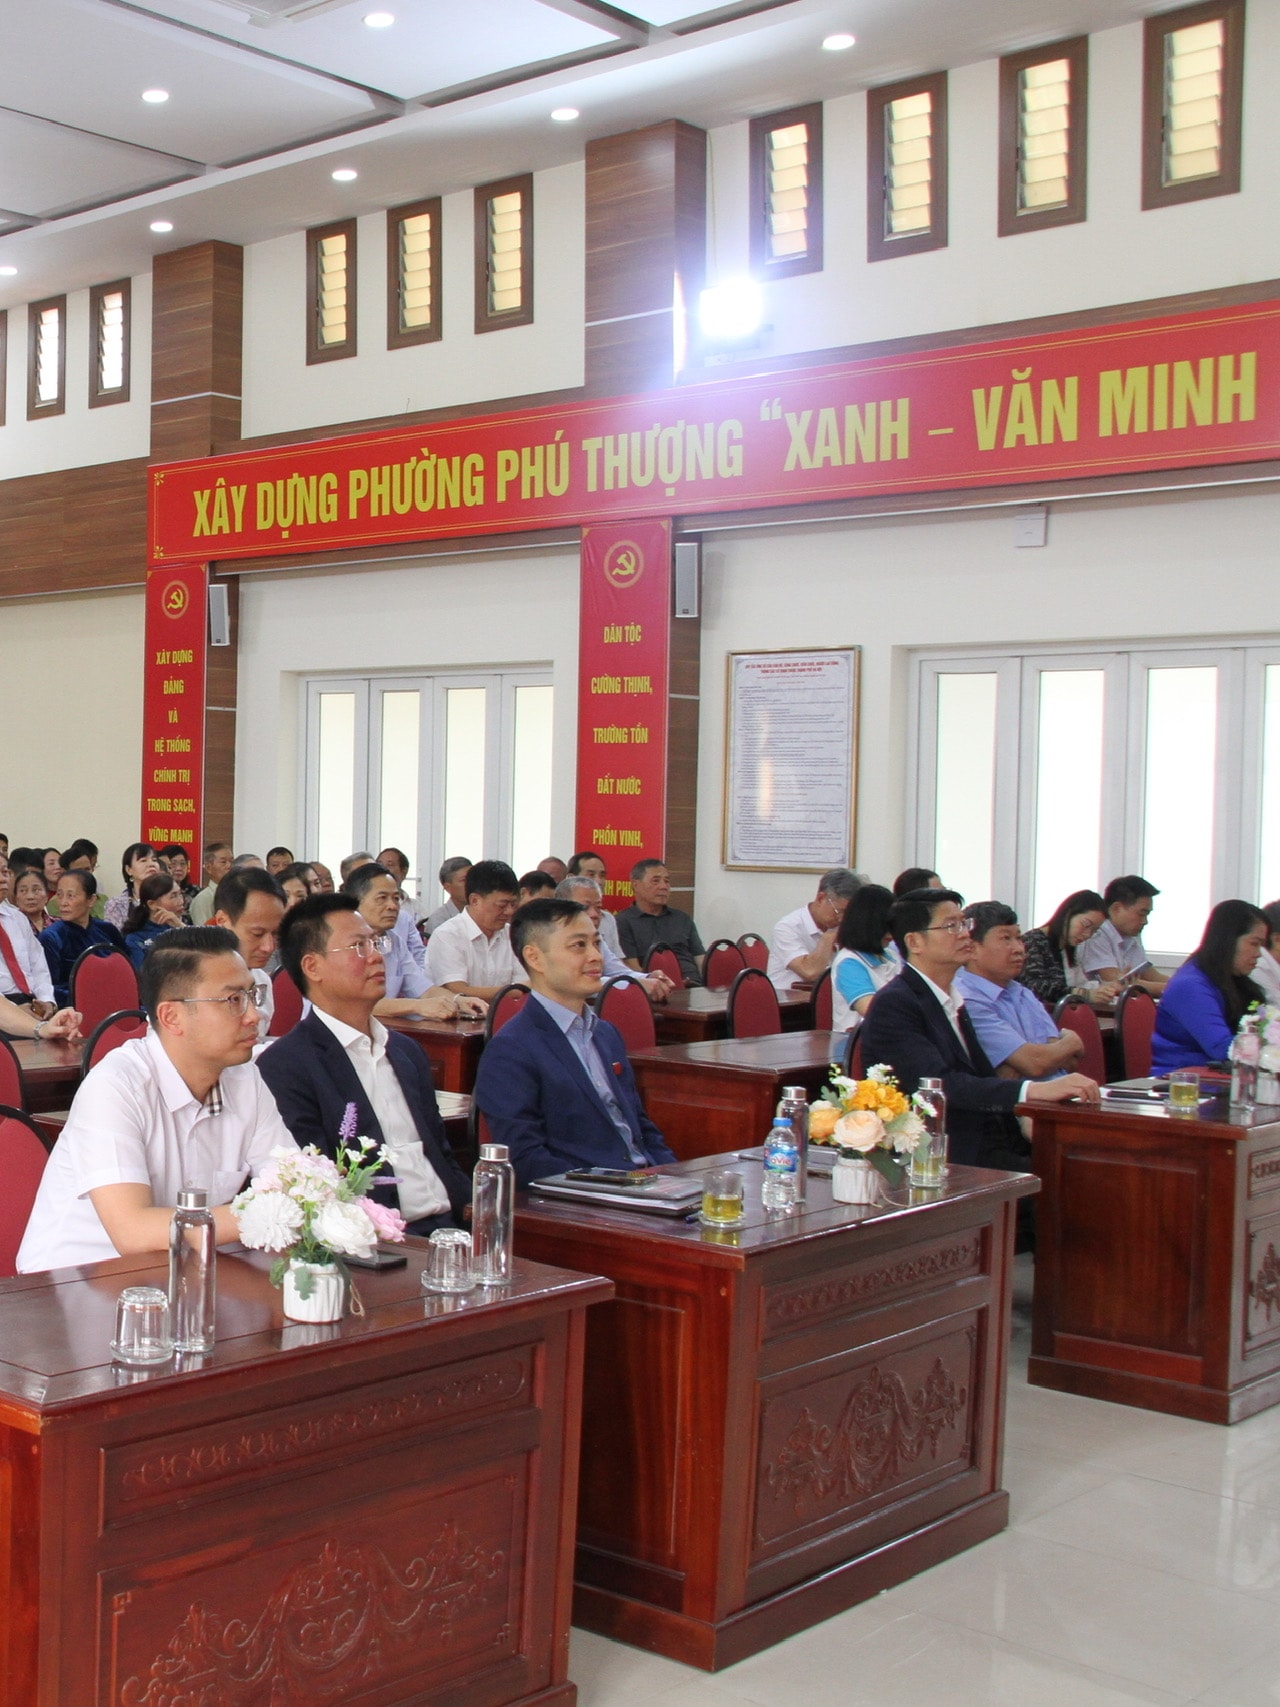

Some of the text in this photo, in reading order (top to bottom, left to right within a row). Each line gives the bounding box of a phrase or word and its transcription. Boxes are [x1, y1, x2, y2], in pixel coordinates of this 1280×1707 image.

[193, 478, 247, 538] XÂY
[256, 472, 338, 538] DỰNG
[349, 447, 484, 520] PHƯỜNG
[497, 430, 570, 502] PHÚ
[582, 419, 743, 497] THƯỢNG
[971, 367, 1078, 451] VĂN
[1099, 351, 1257, 438] MINH
[603, 621, 642, 646] DÂN TỘC
[156, 648, 193, 667] XÂY DỰNG
[163, 675, 184, 695] ĐẢNG
[591, 673, 653, 697] CƯỜNG THỊNH,
[168, 707, 179, 724] VÀ
[593, 721, 648, 744] TRƯỜNG TỒN
[154, 734, 191, 757] HỆ THỐNG
[153, 766, 191, 786] CHÍNH TRỊ
[597, 772, 641, 795] ĐẤT NƯỚC
[147, 798, 196, 815] TRONG SẠCH,
[148, 825, 193, 846] VỮNG MẠNH
[592, 824, 643, 848] PHỒN VINH,
